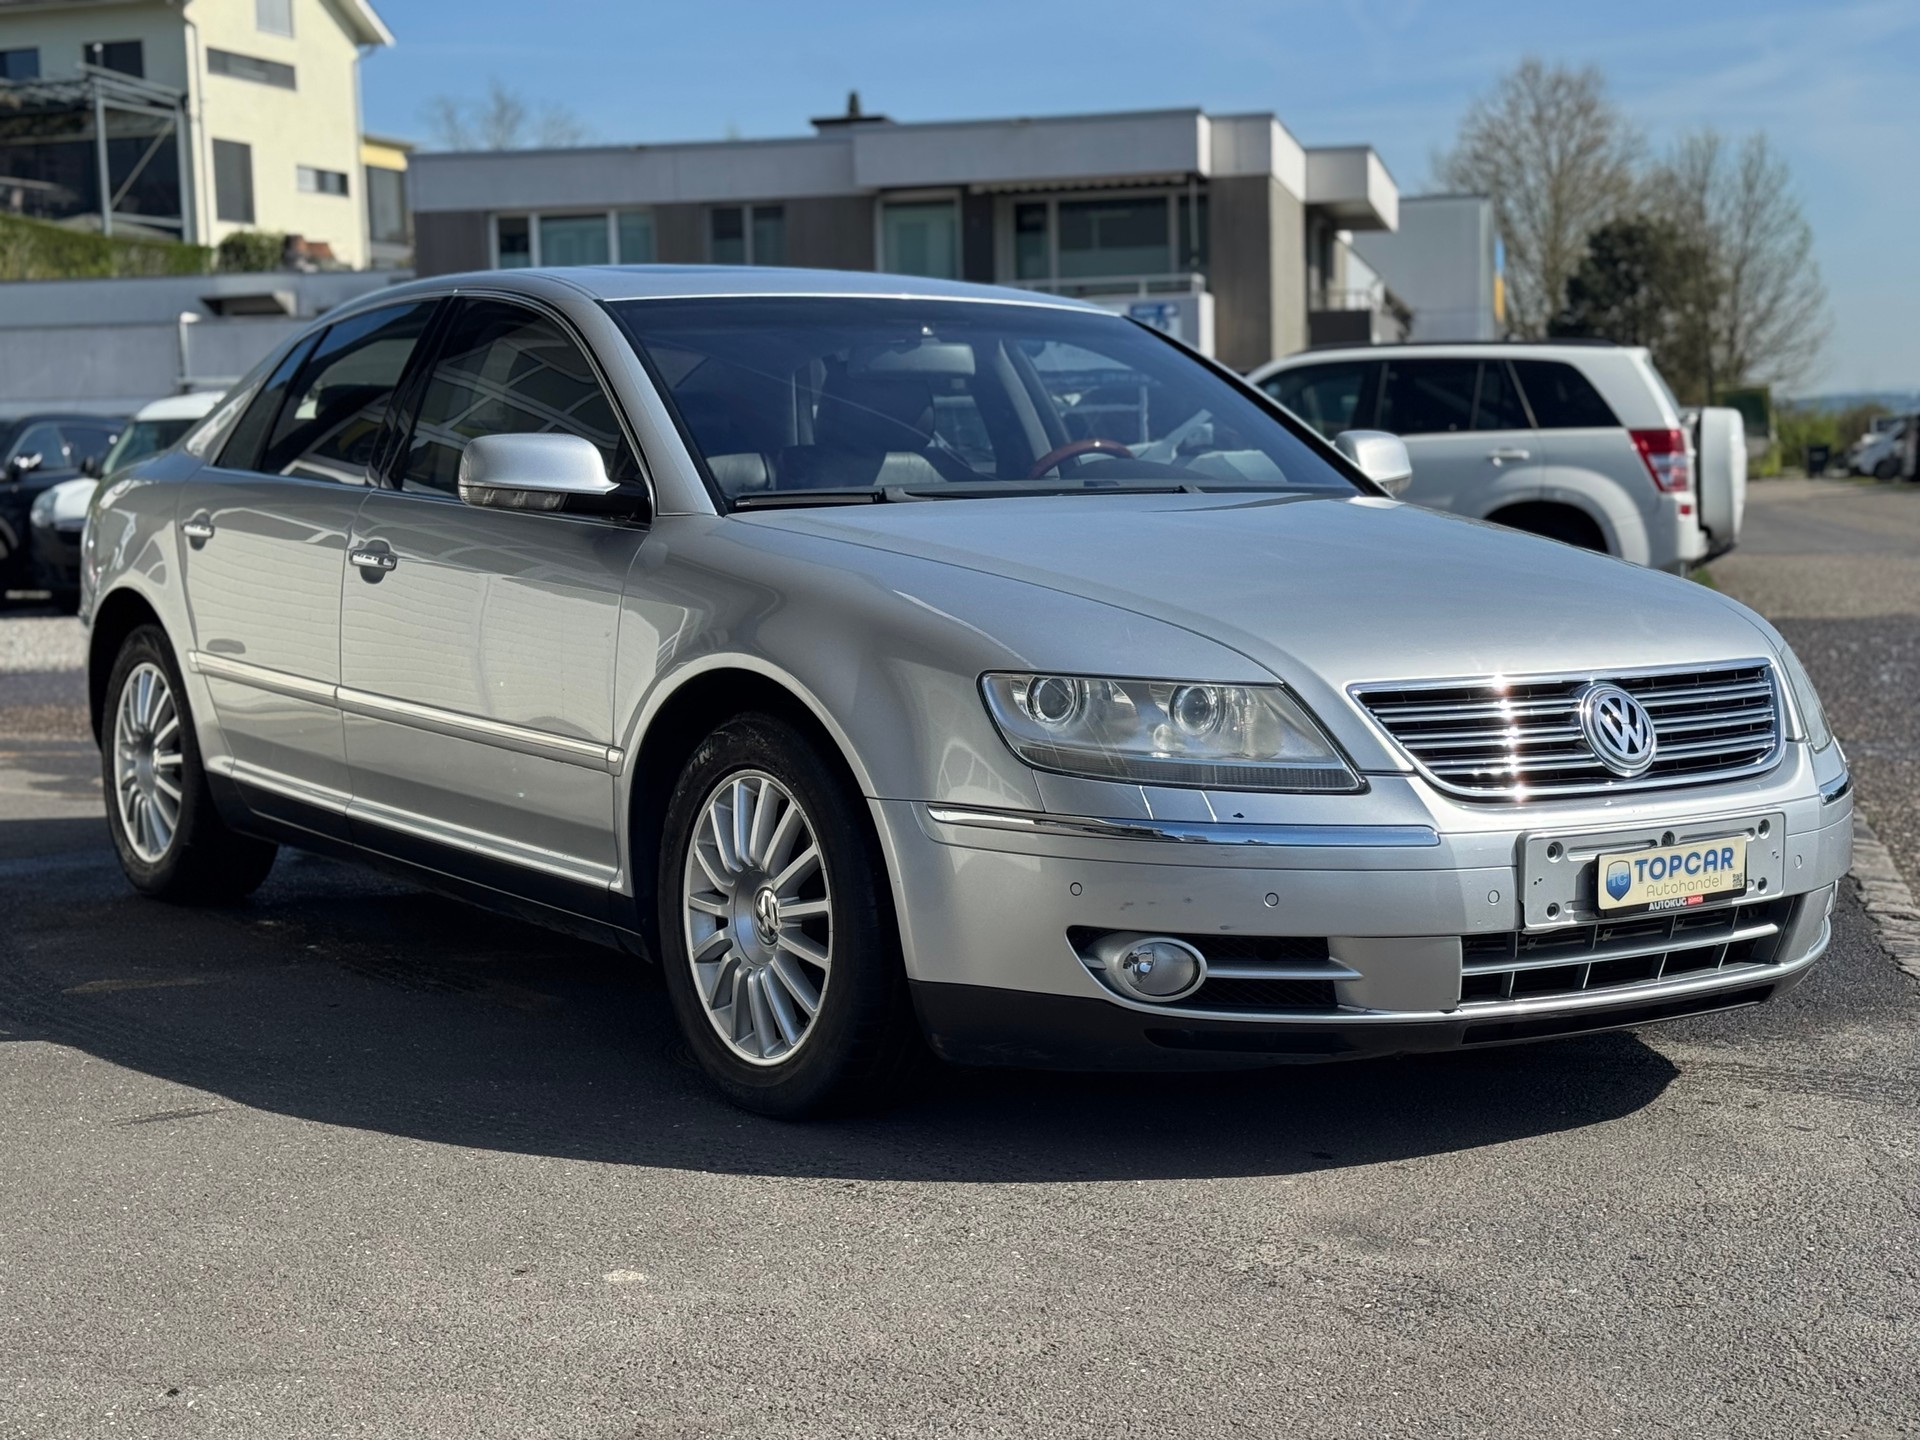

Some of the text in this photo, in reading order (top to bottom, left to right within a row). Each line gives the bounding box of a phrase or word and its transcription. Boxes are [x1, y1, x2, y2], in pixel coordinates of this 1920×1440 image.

[1590, 690, 1653, 763] VW
[1634, 847, 1734, 882] TOPCAR
[1646, 875, 1723, 897] Autohandel
